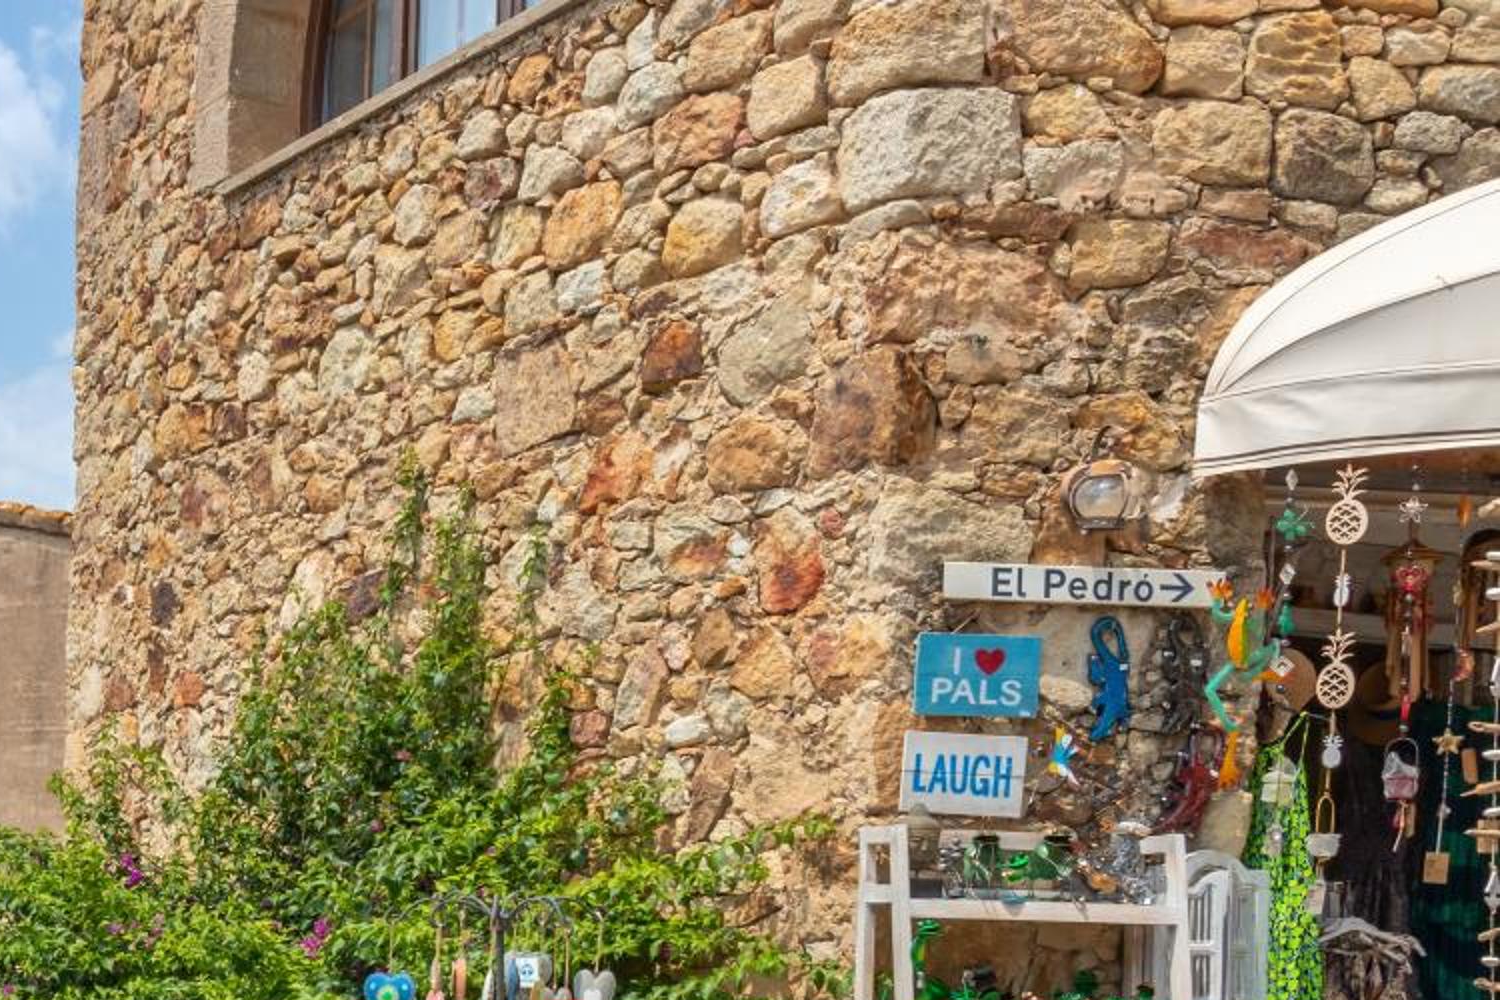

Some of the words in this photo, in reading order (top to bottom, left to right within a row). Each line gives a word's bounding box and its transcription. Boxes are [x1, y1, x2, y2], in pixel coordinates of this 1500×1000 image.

[990, 567, 1026, 598] El
[1043, 568, 1154, 602] Pedró
[953, 647, 961, 676] I
[931, 677, 1022, 706] PALS
[912, 752, 1013, 799] LAUGH
